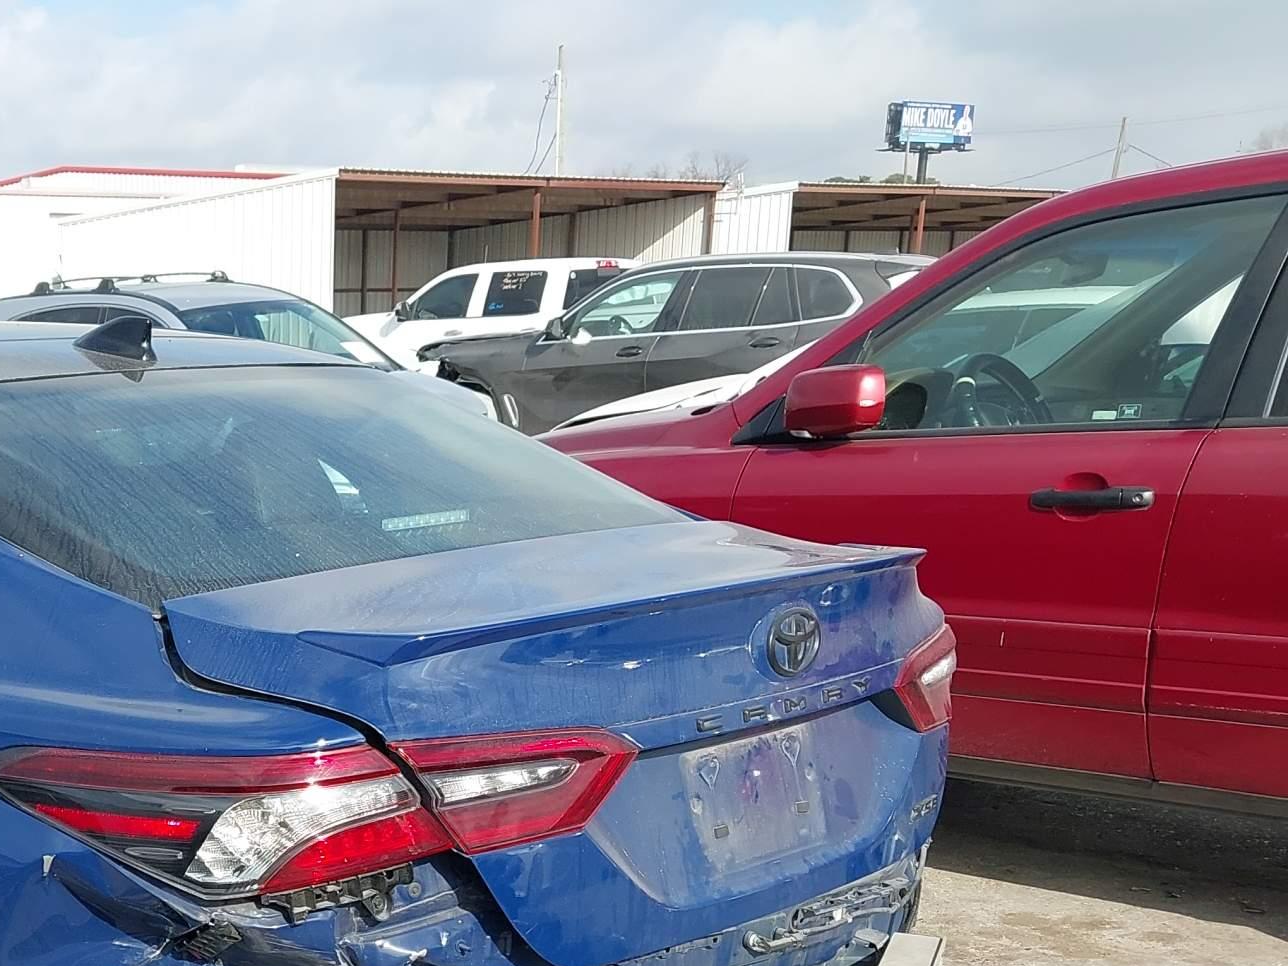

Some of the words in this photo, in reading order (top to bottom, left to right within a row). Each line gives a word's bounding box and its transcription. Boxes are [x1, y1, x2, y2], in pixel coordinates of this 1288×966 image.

[902, 107, 926, 127] MIKE
[927, 108, 956, 128] DOYLE
[695, 676, 871, 733] CAMRY
